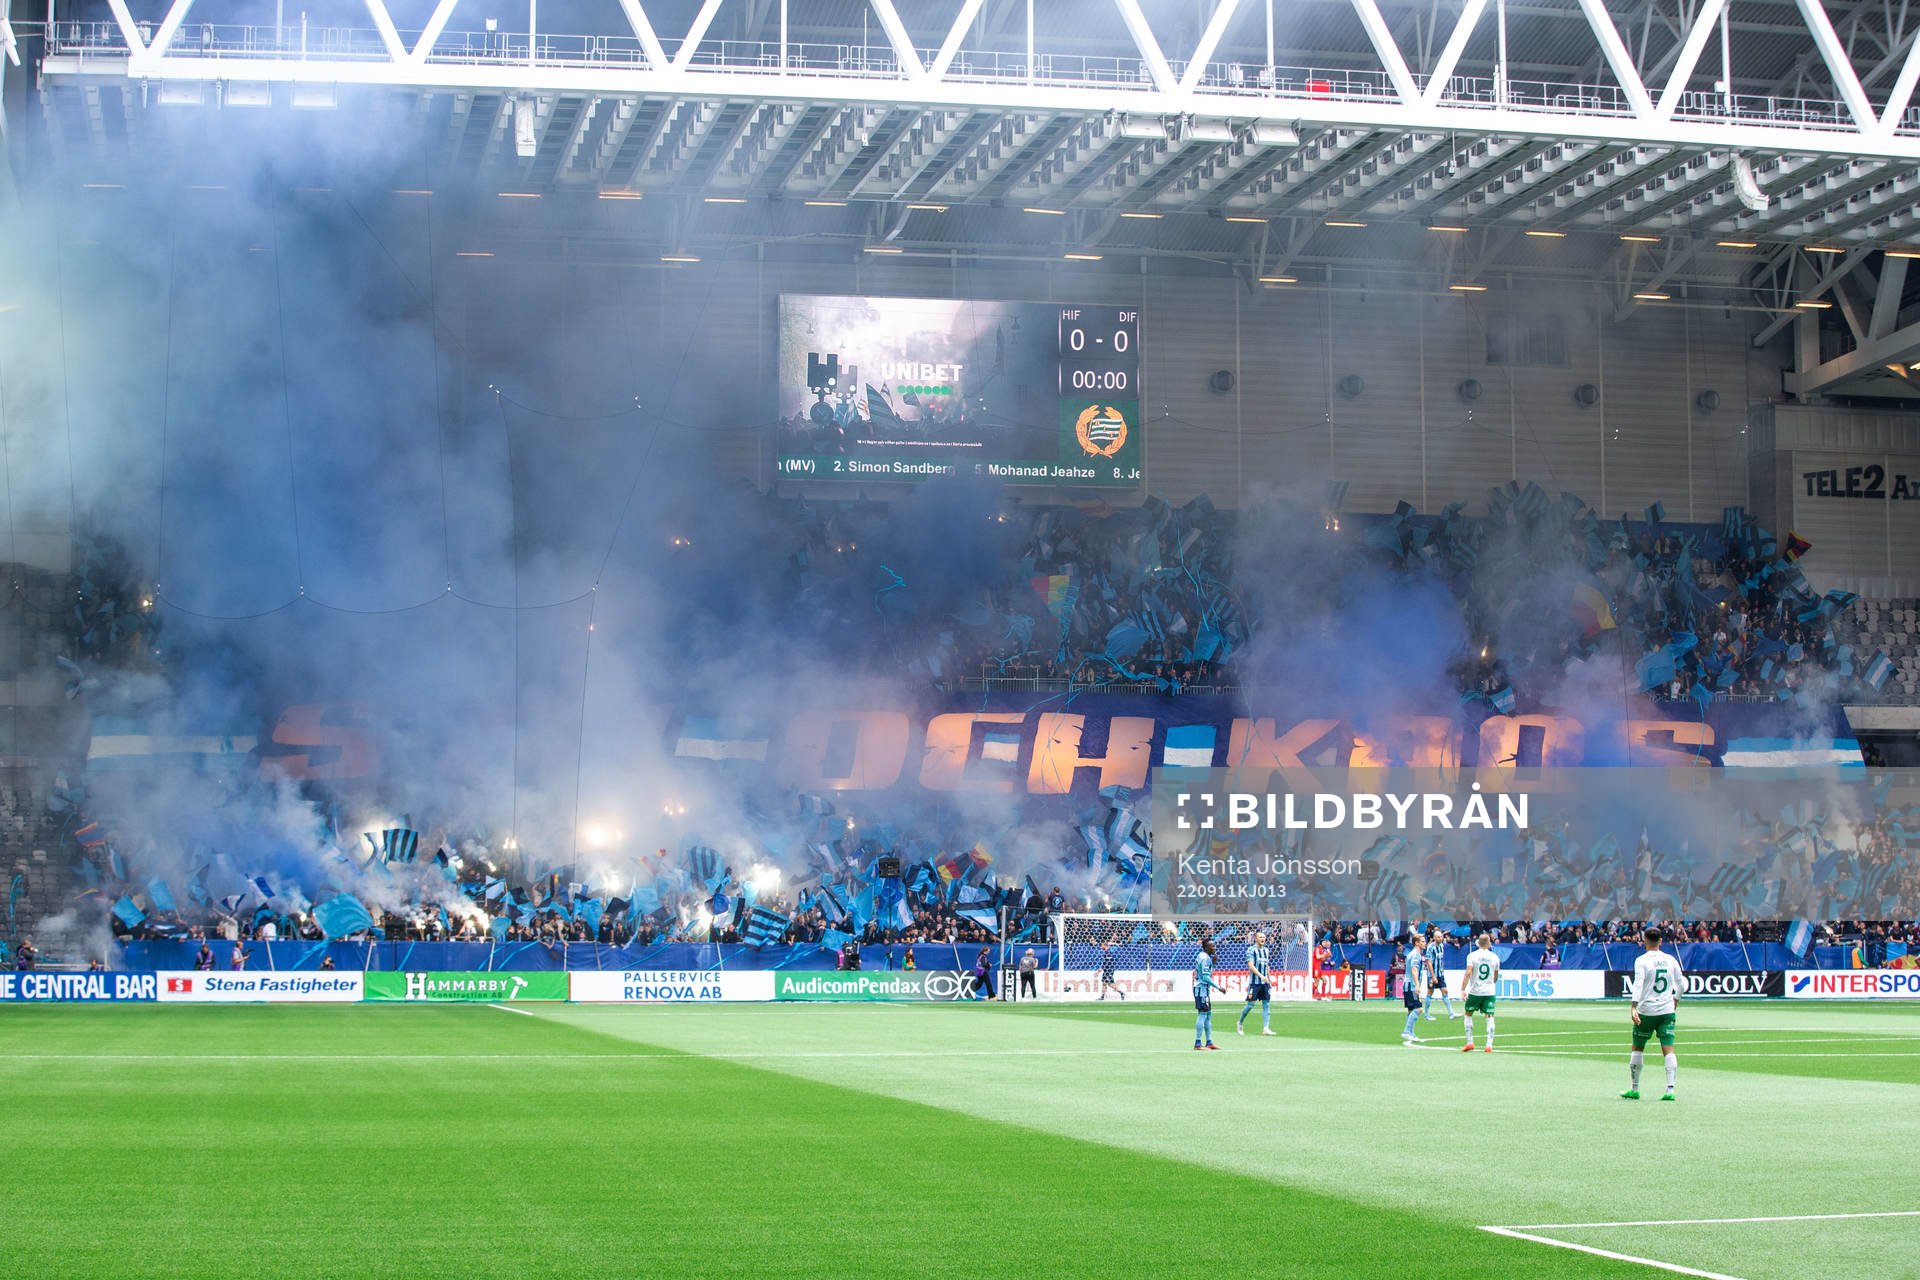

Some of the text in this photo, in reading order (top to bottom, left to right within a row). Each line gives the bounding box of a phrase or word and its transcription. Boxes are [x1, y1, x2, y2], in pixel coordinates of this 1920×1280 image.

[1062, 309, 1137, 322] HIF DIF
[1070, 328, 1085, 351] 0
[1114, 330, 1128, 353] 0
[881, 362, 963, 382] UNIBET
[1072, 370, 1127, 390] 00:00
[785, 459, 816, 474] (MV)
[833, 460, 845, 472] 2.
[848, 460, 890, 473] Simon
[988, 463, 1048, 477] Mohanad
[1050, 466, 1096, 479] Jeahze
[1113, 467, 1125, 479] 8.
[1803, 464, 1886, 499] TELE2
[776, 710, 1156, 795] OCH
[624, 972, 721, 982] PALLSERVICE
[1478, 963, 1491, 981] 9
[1652, 968, 1668, 994] 5
[21, 974, 112, 999] CENTRAL
[115, 975, 156, 999] BAR
[205, 977, 358, 994] Stena Fastigheter
[405, 972, 508, 1000] HAMMARBY
[624, 986, 722, 999] RENOVA AB
[782, 976, 920, 994] AudicomPendax
[1005, 969, 1015, 1001] SELECT
[1354, 968, 1364, 1001] SELECT
[1814, 974, 1920, 993] INTERSPO
